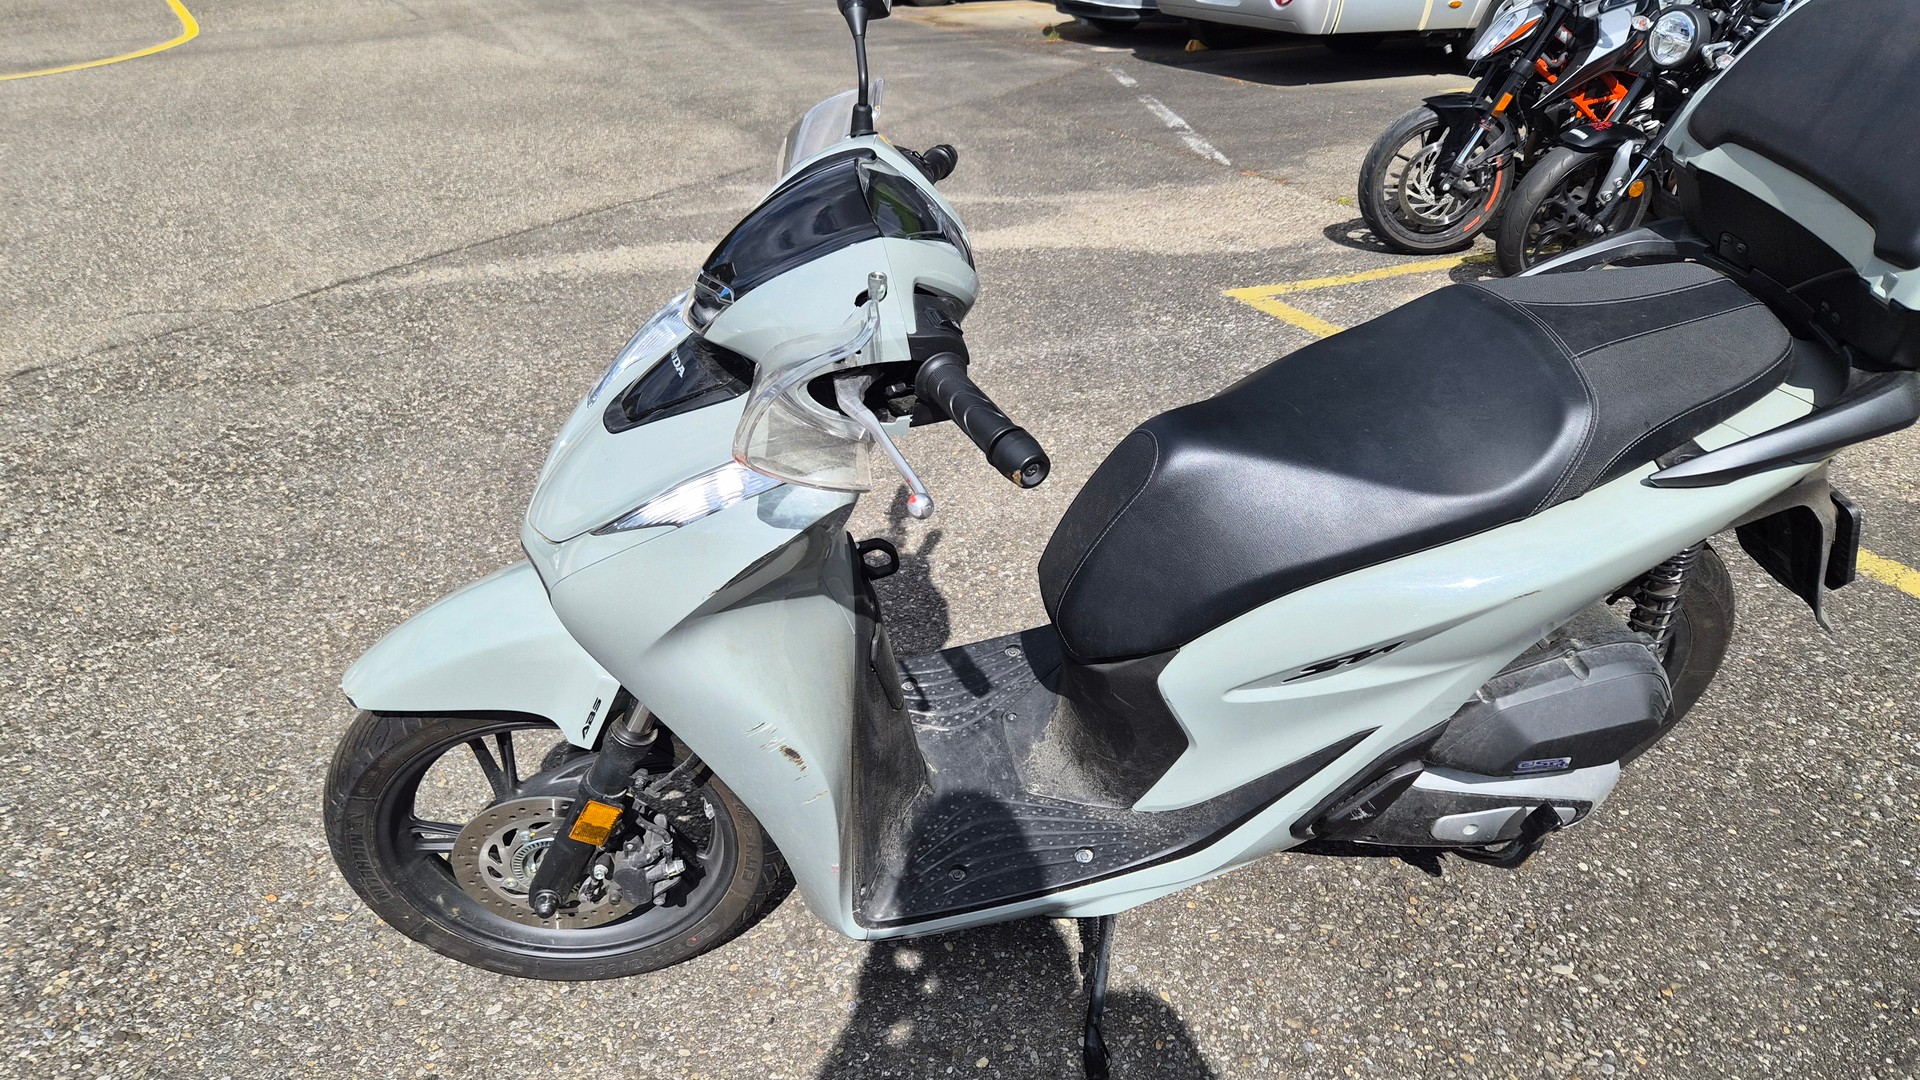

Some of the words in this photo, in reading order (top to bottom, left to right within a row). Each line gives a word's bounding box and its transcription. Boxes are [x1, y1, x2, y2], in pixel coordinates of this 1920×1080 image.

[670, 346, 685, 378] NDA
[581, 697, 602, 741] ABS
[349, 833, 393, 903] MICHELIN
